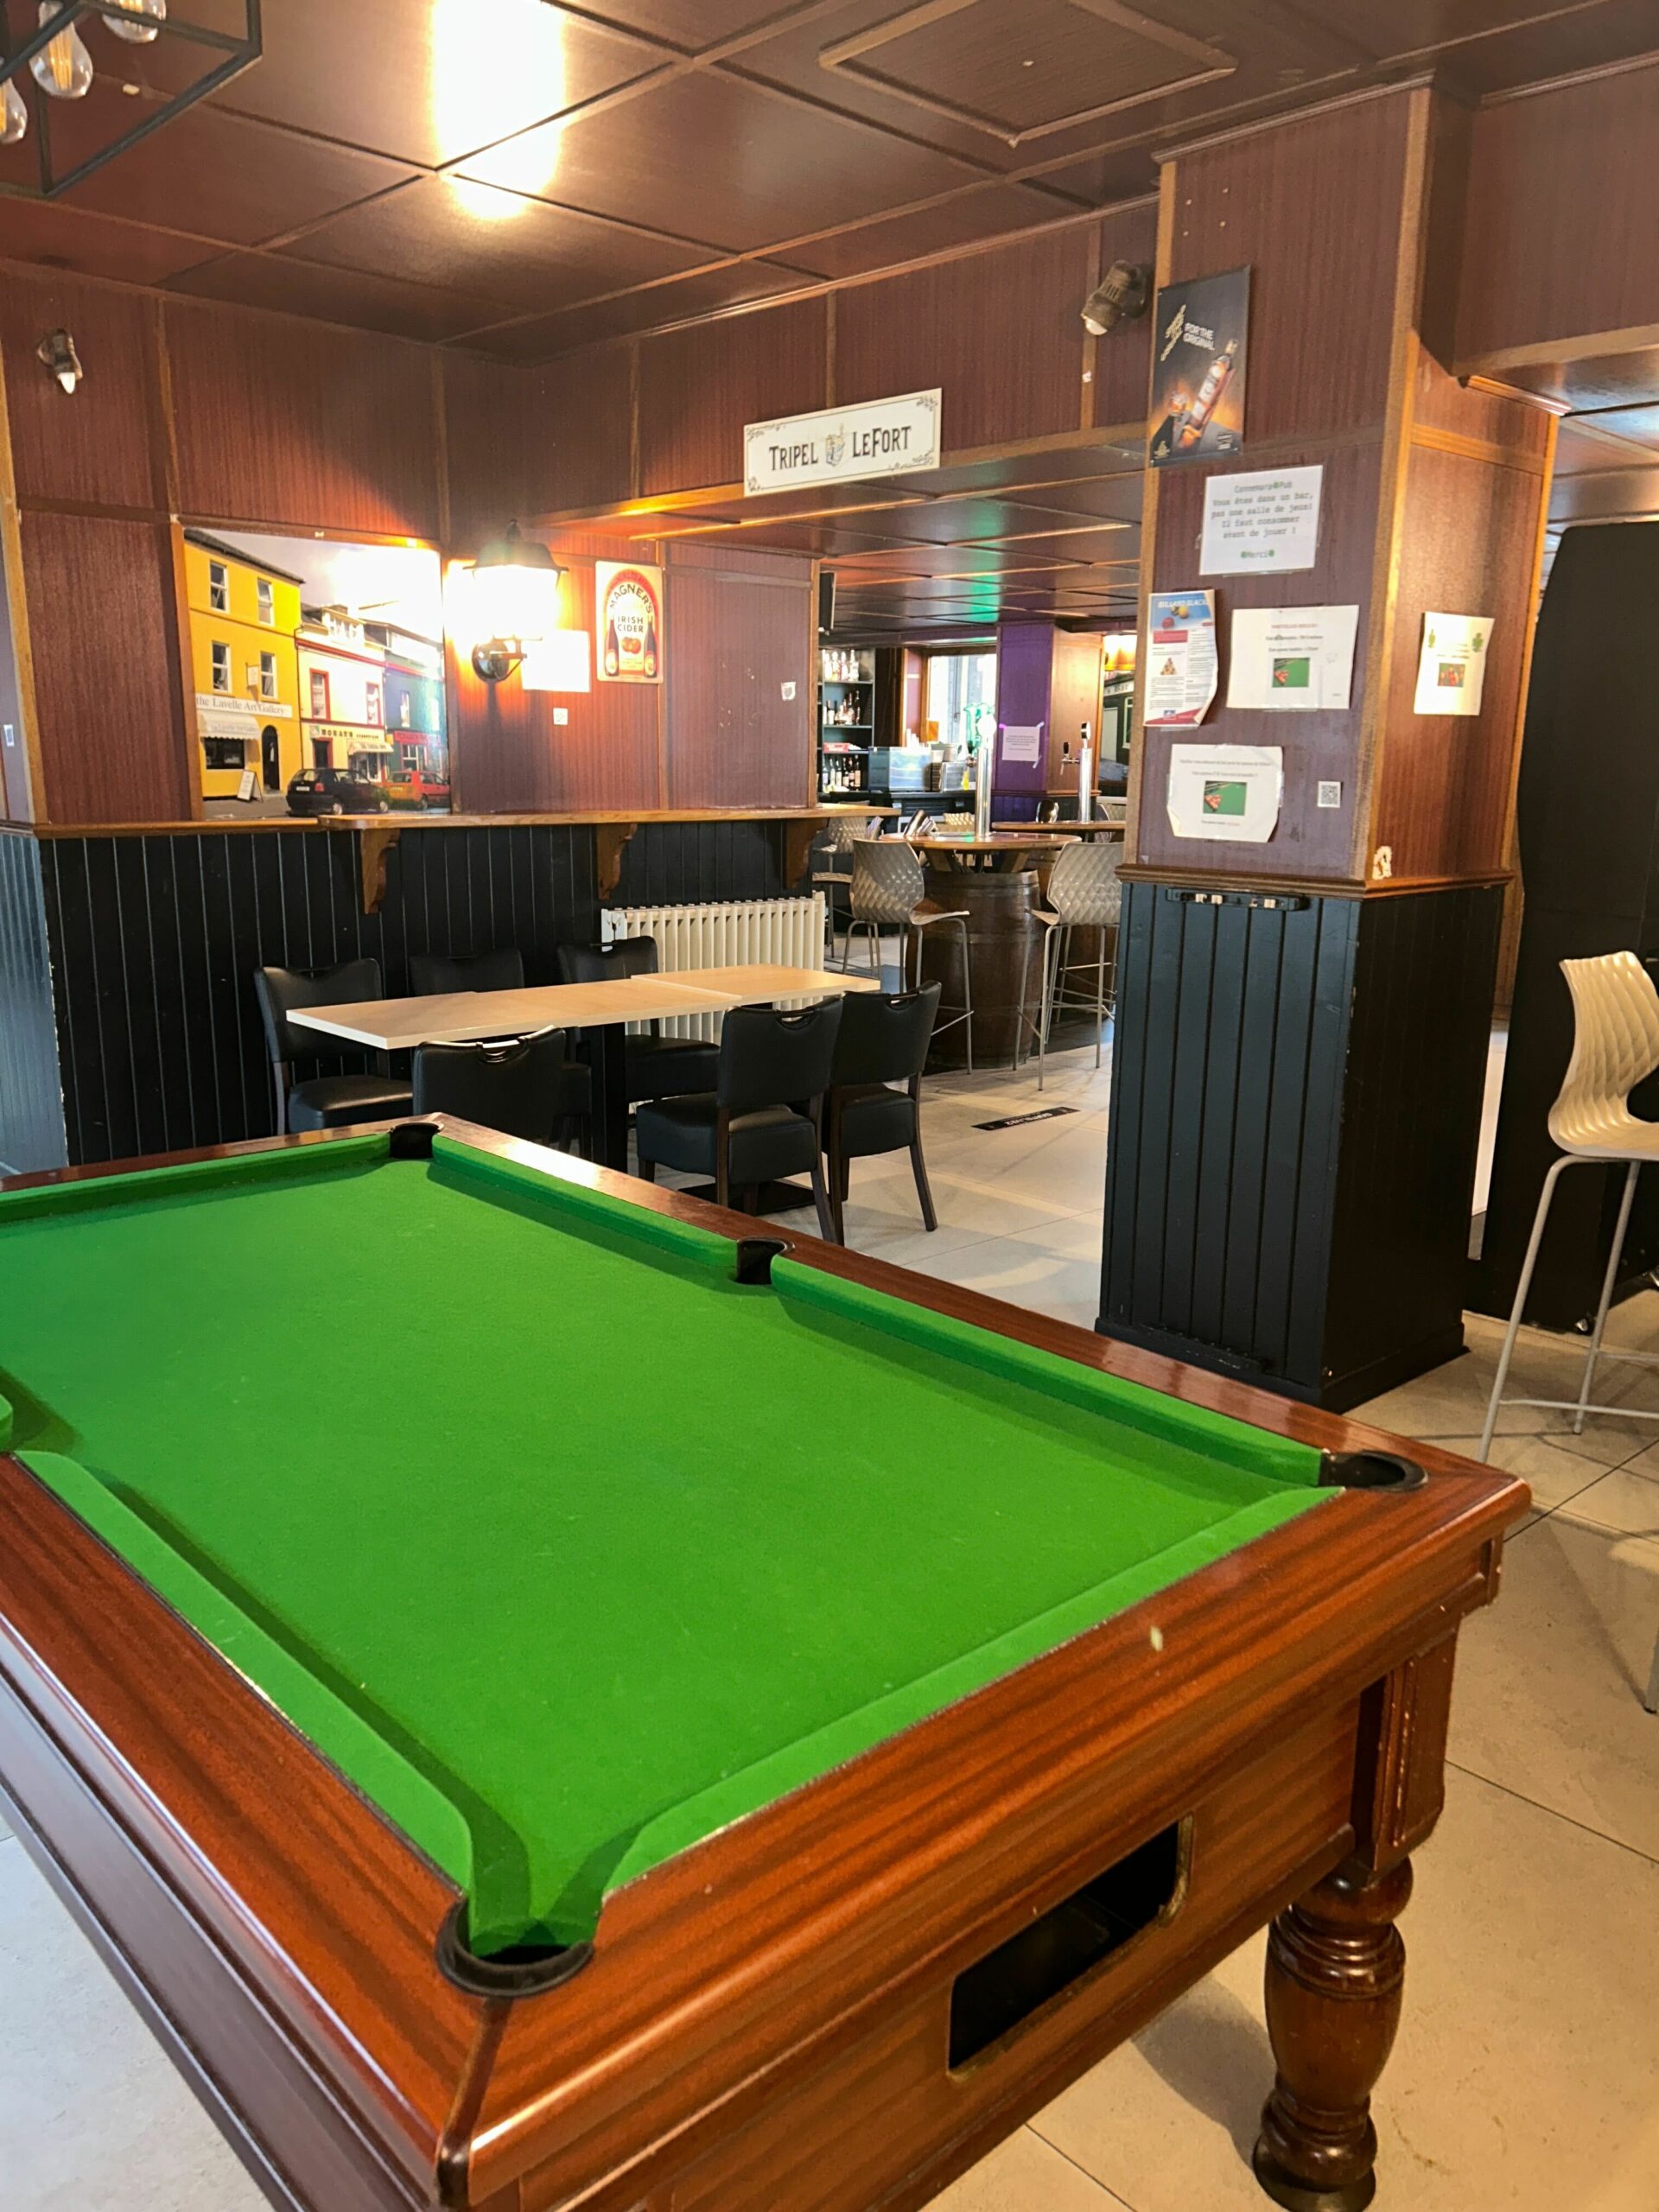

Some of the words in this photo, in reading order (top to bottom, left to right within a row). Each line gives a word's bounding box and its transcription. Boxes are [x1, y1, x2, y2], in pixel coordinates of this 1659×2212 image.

[769, 442, 818, 471] TRIPEL
[1211, 511, 1224, 519] pas
[1247, 506, 1270, 515] salle
[1235, 518, 1253, 527] faut
[1257, 516, 1300, 525] consommer
[1263, 527, 1287, 537] jouer
[618, 615, 644, 625] IRISH
[617, 624, 644, 632] CIDER
[213, 697, 241, 710] Lavelle
[257, 702, 283, 716] Gallery
